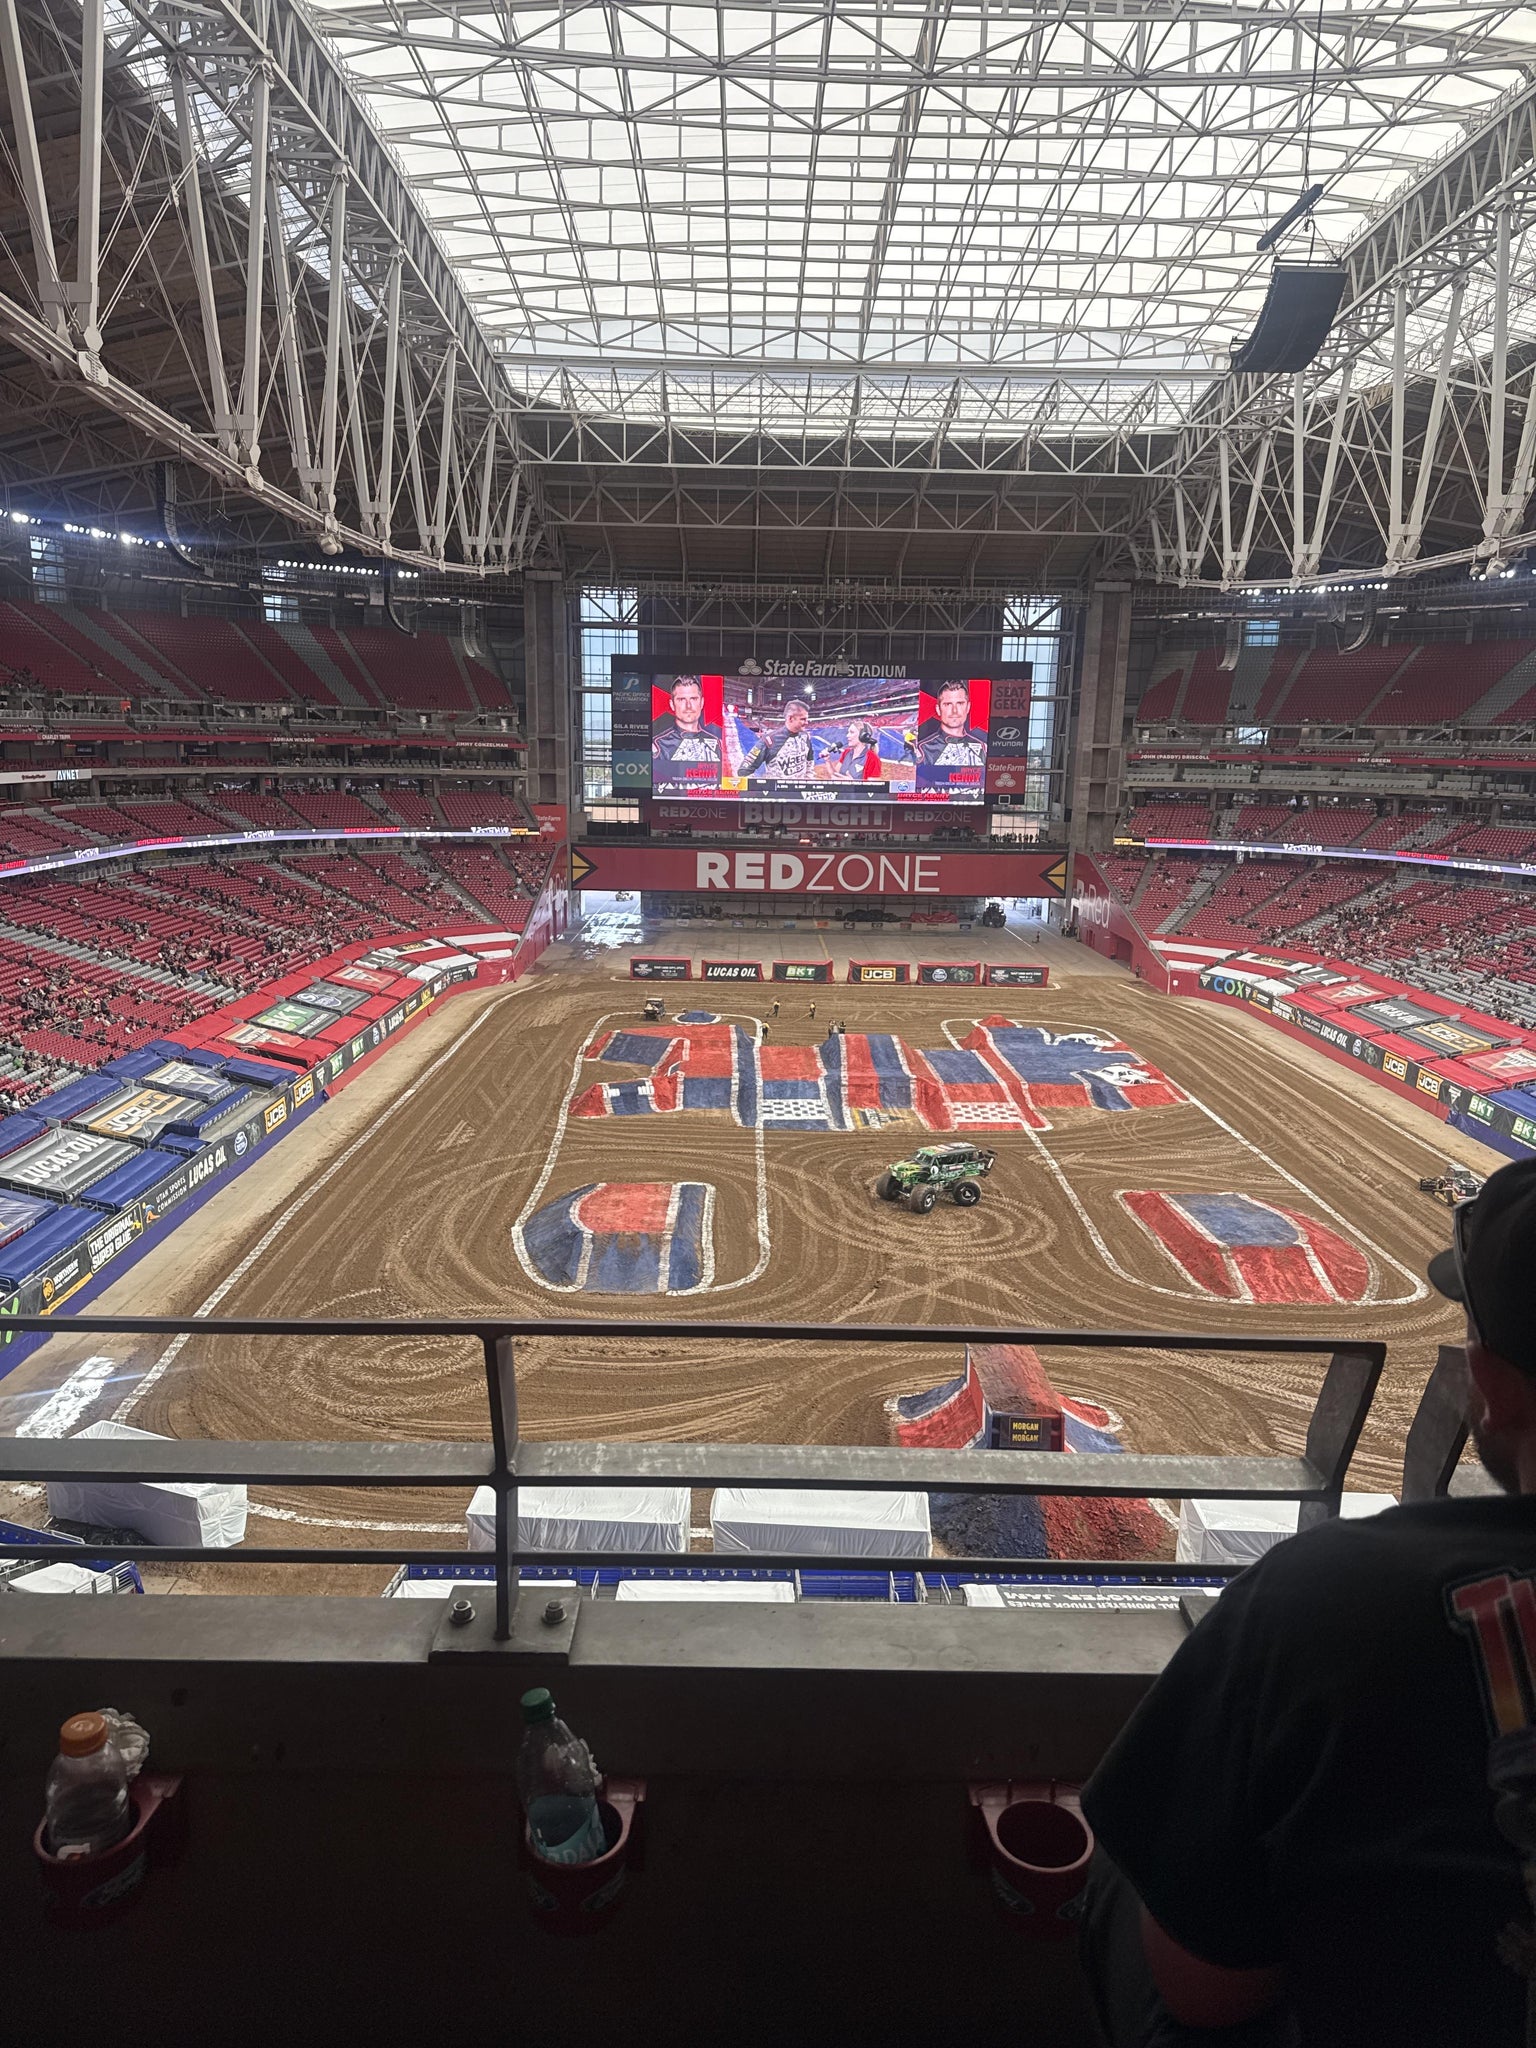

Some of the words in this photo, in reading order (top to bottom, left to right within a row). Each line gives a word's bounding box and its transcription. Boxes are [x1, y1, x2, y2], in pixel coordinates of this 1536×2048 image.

[847, 664, 906, 678] STADIUM
[996, 686, 1026, 698] SEAT
[993, 700, 1026, 710] GEEK
[615, 763, 649, 776] COX
[686, 768, 718, 778] KENNY
[949, 773, 982, 783] KENNY
[744, 803, 801, 825] BUD
[806, 804, 887, 826] LIGHT
[696, 851, 941, 893] REDZONE
[707, 967, 739, 977] LUCAS
[740, 967, 757, 978] OIL
[787, 966, 816, 978] BKT
[864, 969, 894, 980] JCB
[1213, 976, 1245, 999] COX
[264, 1004, 310, 1031] BKT
[1320, 1024, 1337, 1042] LUCAS
[1336, 1033, 1348, 1048] OIL
[1385, 1059, 1406, 1076] JCB
[295, 1079, 313, 1101] JCB
[1420, 1076, 1439, 1093] JCB
[267, 1103, 286, 1128] JCB
[1469, 1095, 1495, 1119] BKT
[13, 1149, 80, 1186] LUCAS
[66, 1133, 108, 1153] OIL
[188, 1154, 214, 1189] LUCAS
[215, 1145, 228, 1168] OIL
[155, 1187, 169, 1203] UTAH
[169, 1175, 186, 1192] SPORTS
[157, 1185, 188, 1213] COMMISSION
[90, 1235, 105, 1254] THE
[103, 1214, 134, 1244] ORIGINAL
[91, 1245, 115, 1270] SUPER
[114, 1229, 132, 1253] GLUE
[1012, 1421, 1039, 1431] MORGAN
[1012, 1433, 1039, 1442] MORGAN
[1008, 1600, 1051, 1609] SERIES
[1054, 1601, 1096, 1610] TRUCK
[1098, 1601, 1157, 1610] MONSTER
